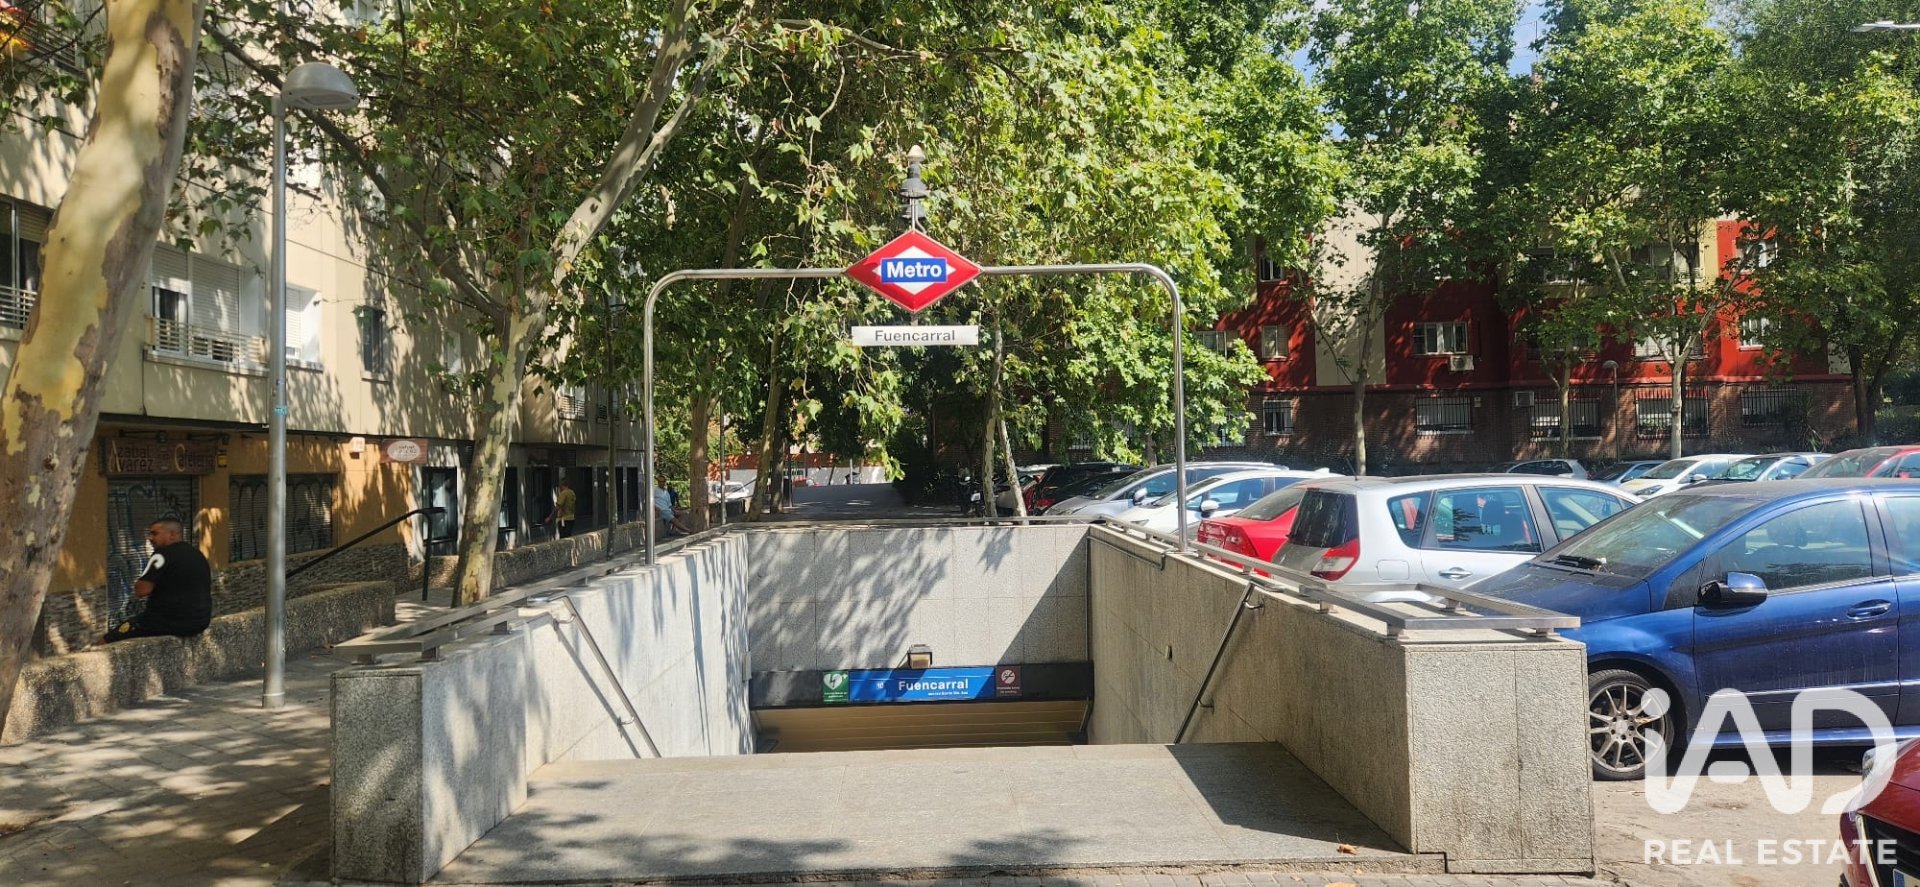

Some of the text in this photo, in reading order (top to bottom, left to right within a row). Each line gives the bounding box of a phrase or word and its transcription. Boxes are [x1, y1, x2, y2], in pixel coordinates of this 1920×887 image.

[886, 261, 943, 278] Metro
[875, 330, 955, 342] Fuencarral
[898, 679, 968, 691] Fuencarral
